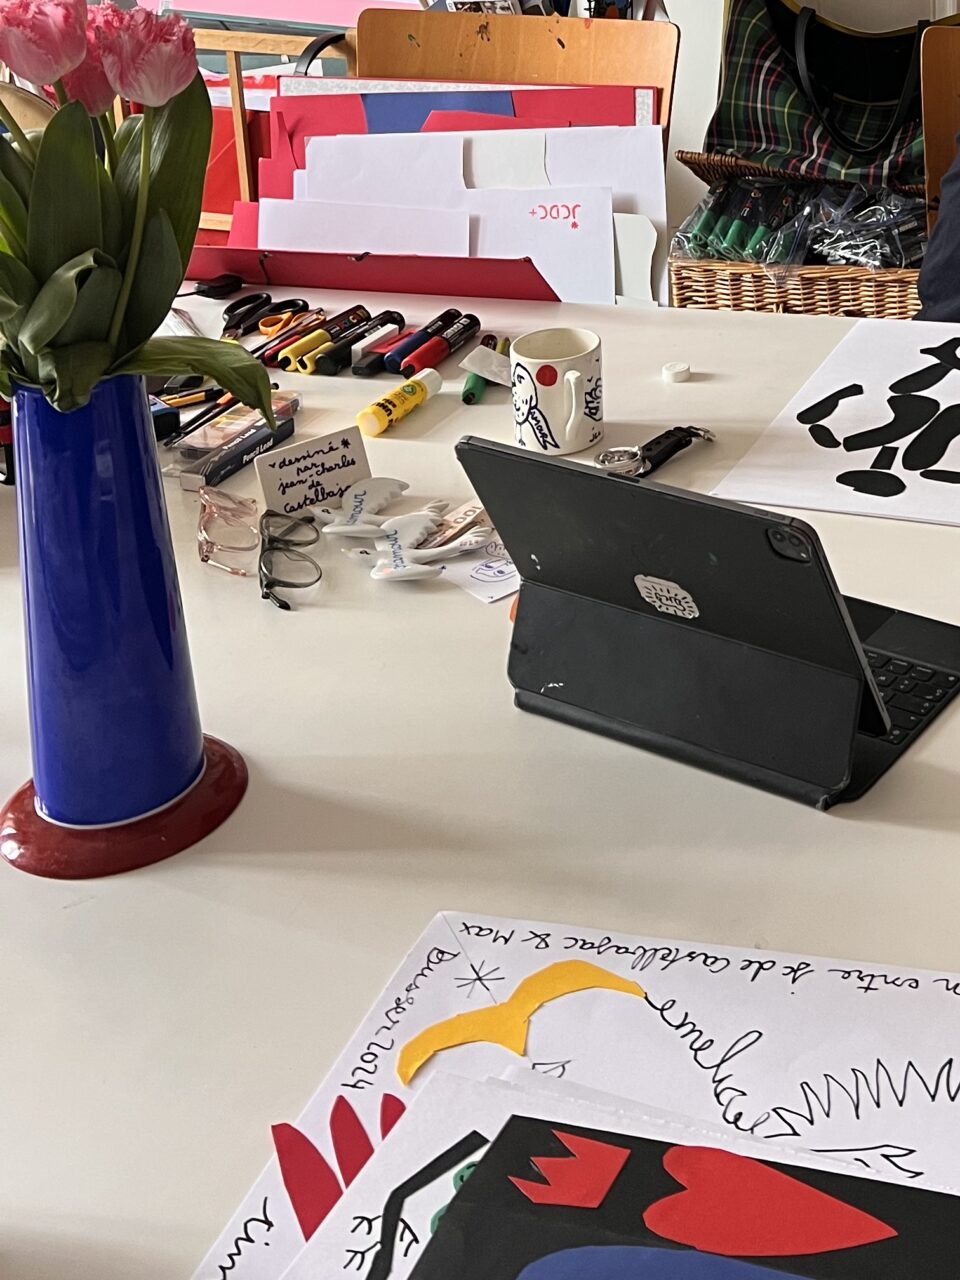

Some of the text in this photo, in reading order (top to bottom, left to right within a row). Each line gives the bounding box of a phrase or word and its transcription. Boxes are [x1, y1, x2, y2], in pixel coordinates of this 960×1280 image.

[278, 441, 339, 469] dessiné
[297, 462, 321, 476] par
[284, 483, 352, 514] Castelbaj
[459, 921, 516, 946] Max
[520, 929, 554, 950] &
[739, 954, 778, 982] de
[828, 967, 921, 994] entre
[341, 1038, 395, 1090] 2024
